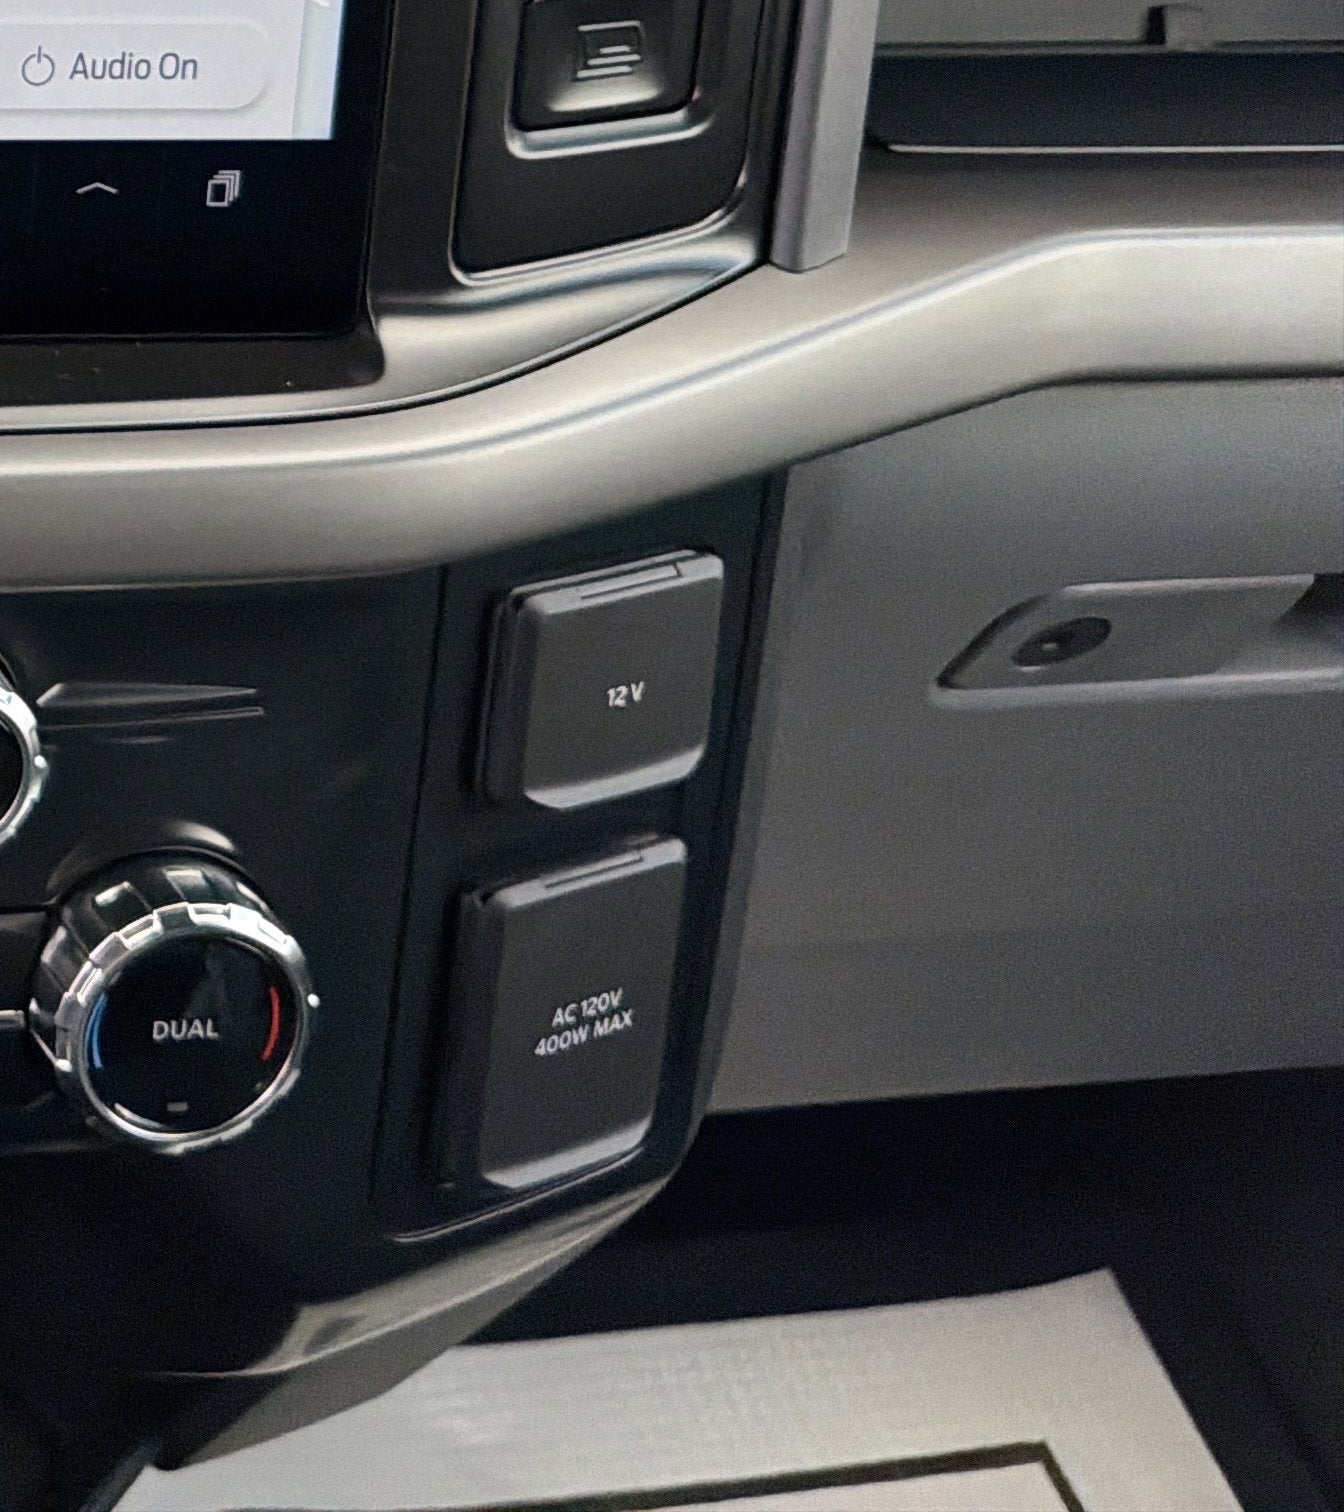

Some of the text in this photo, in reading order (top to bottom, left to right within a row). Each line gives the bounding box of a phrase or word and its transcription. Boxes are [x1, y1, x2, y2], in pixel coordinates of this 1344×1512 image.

[69, 50, 199, 82] Audio On
[607, 685, 628, 708] 12
[552, 987, 623, 1027] AC 120V
[152, 1019, 219, 1042] DUAL
[534, 1008, 634, 1056] 400W MAX
